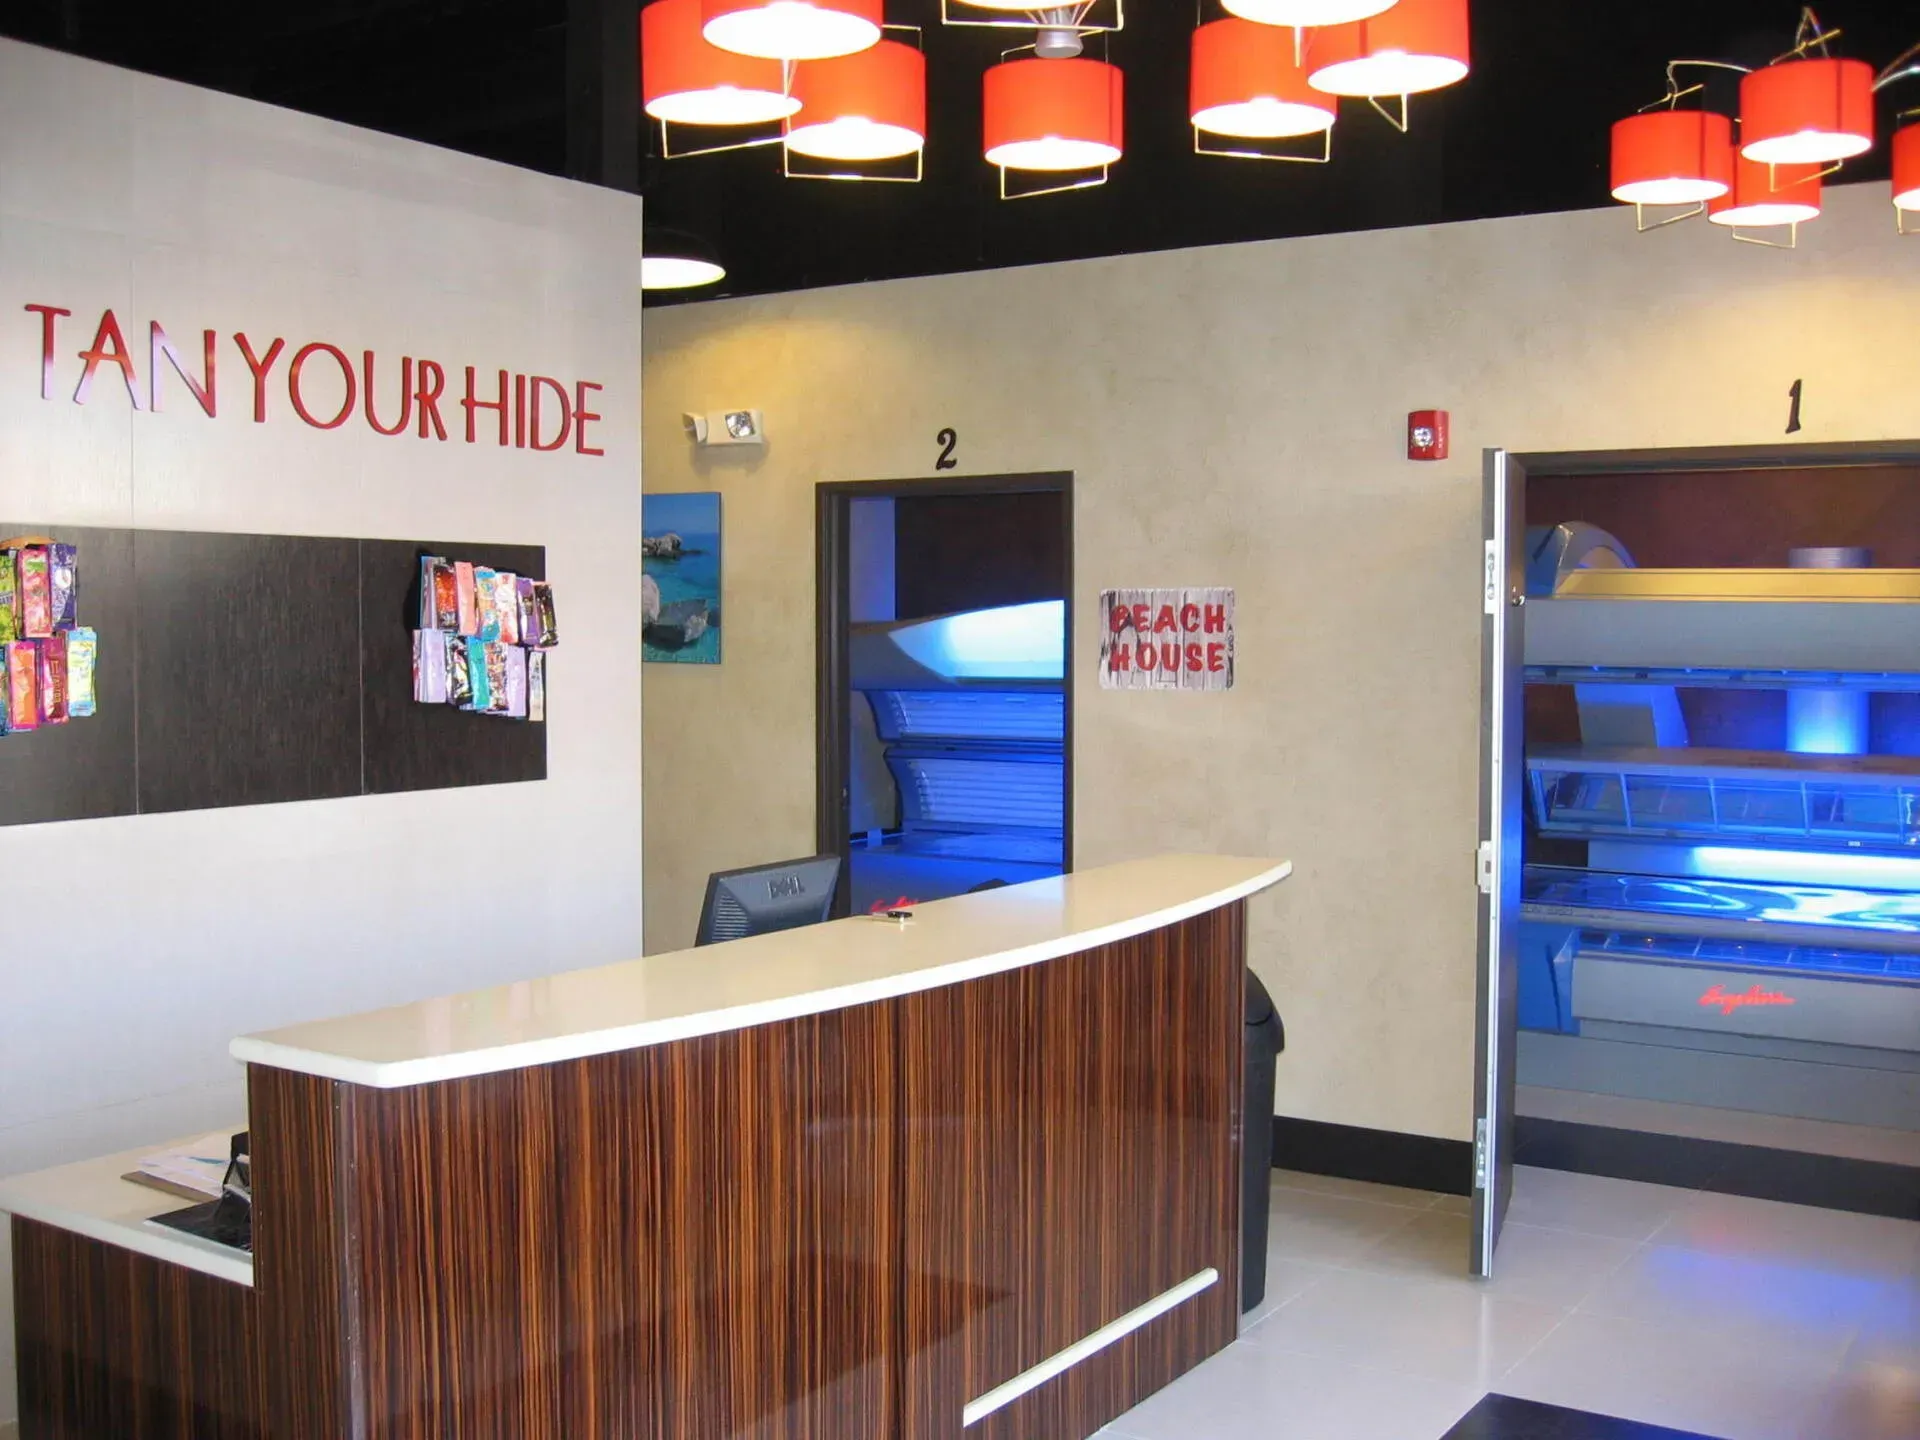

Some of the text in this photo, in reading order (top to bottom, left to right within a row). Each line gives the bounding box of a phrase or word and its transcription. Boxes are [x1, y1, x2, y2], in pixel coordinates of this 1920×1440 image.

[24, 303, 604, 456] TAN YOUR HIDE
[1785, 378, 1802, 434] 1
[935, 427, 957, 471] 2
[1109, 603, 1226, 633] BEACH
[1110, 642, 1226, 672] HOUSE
